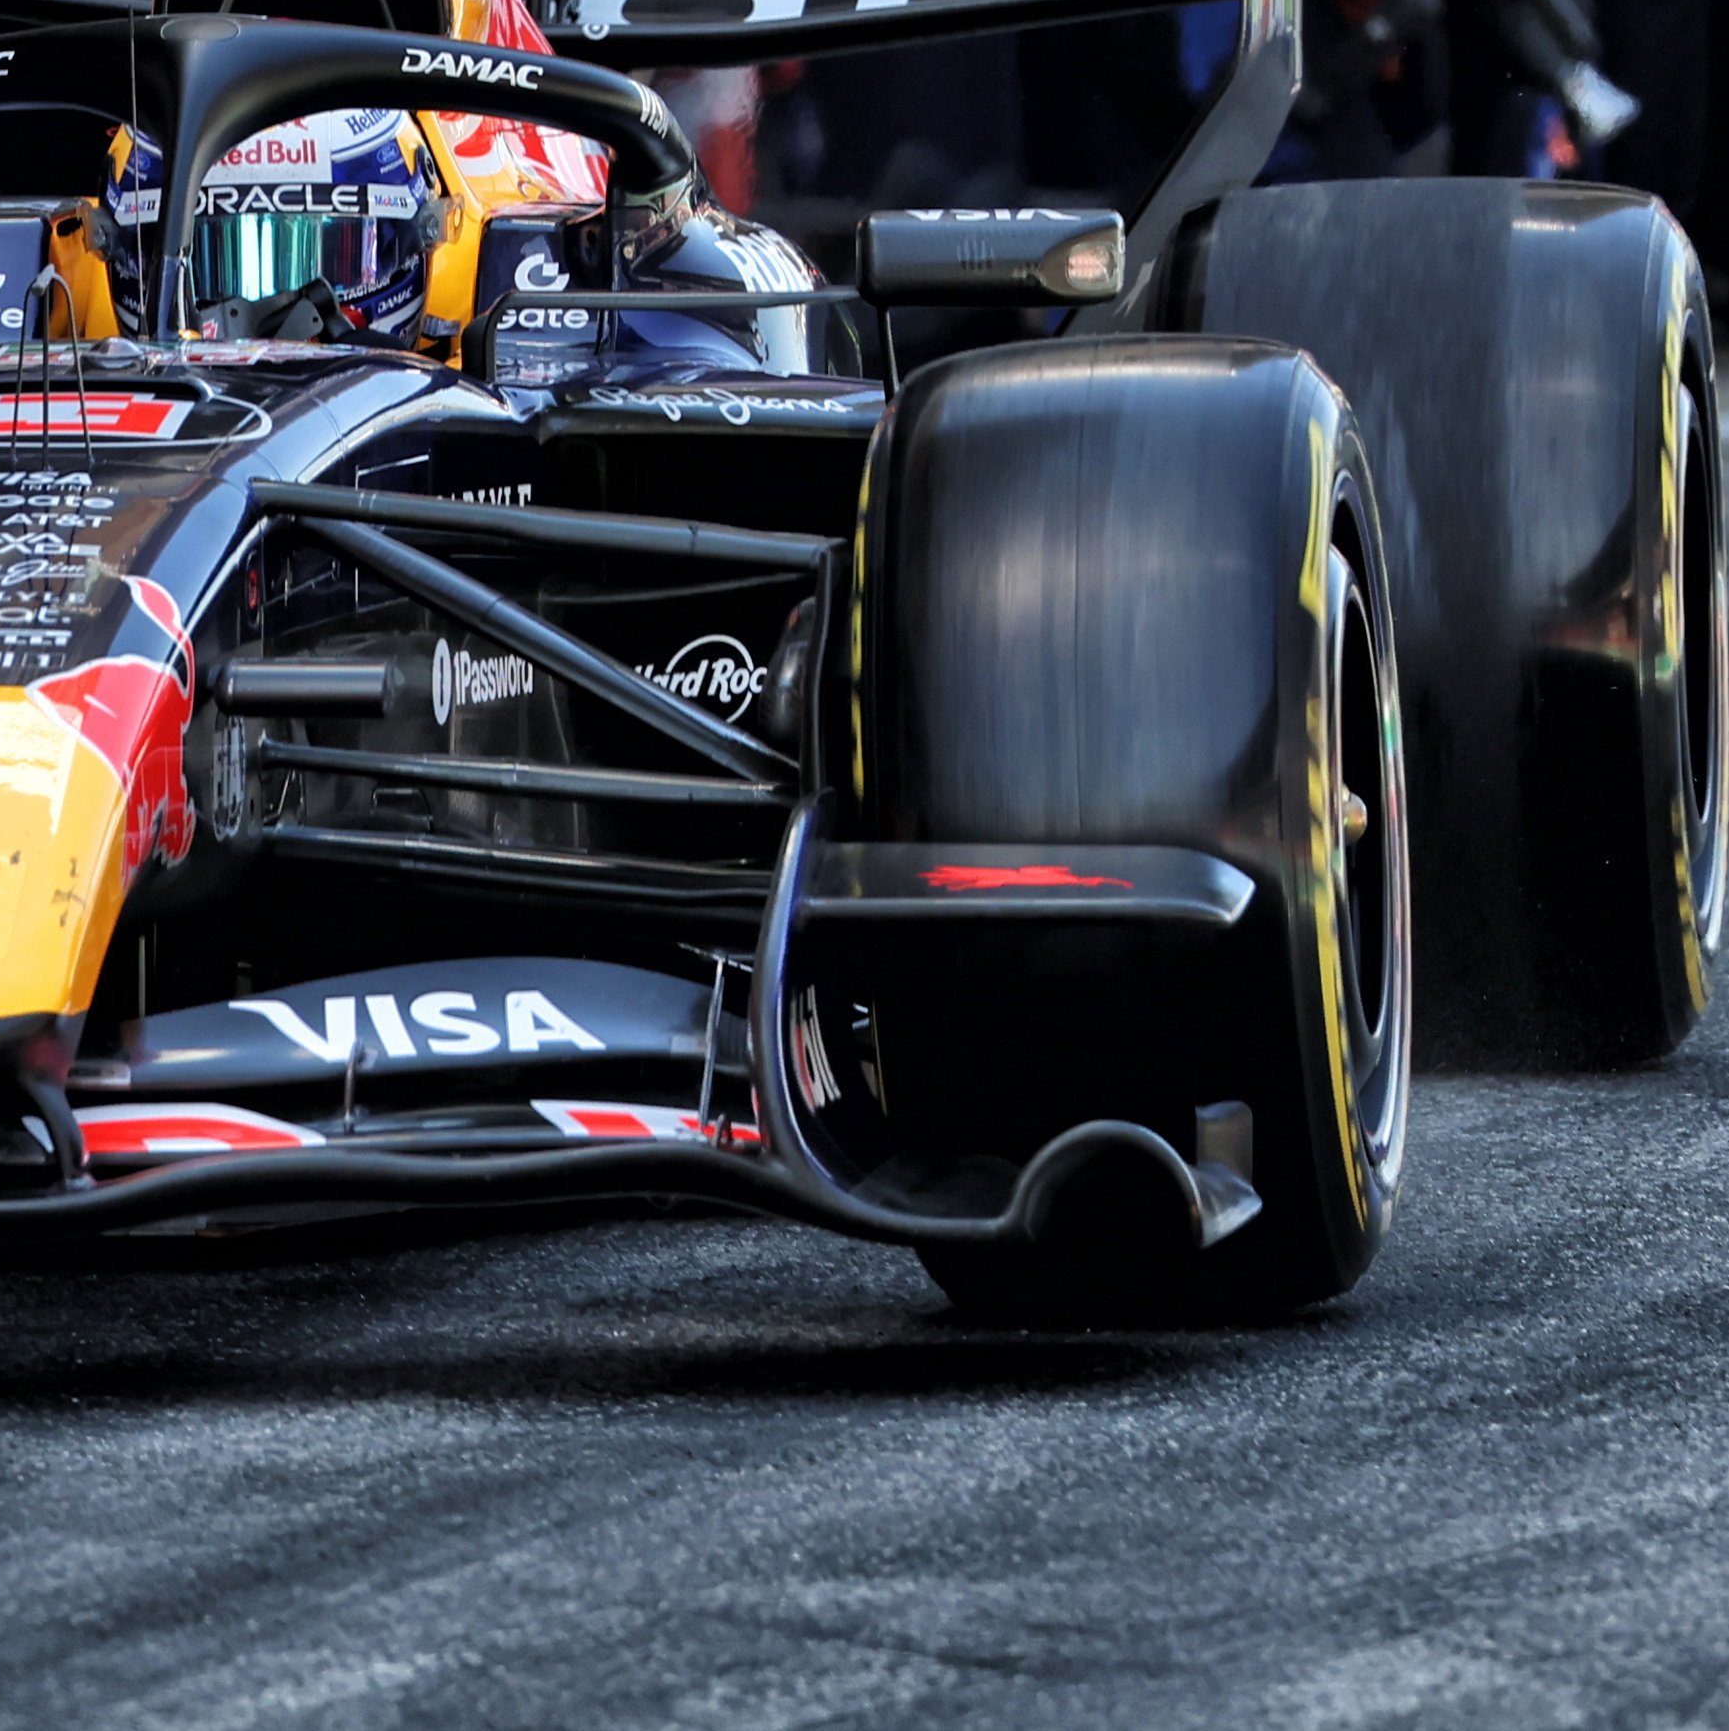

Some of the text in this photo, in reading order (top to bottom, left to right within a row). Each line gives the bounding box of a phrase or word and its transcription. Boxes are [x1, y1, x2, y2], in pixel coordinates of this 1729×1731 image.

[401, 47, 544, 91] DAMAC
[266, 139, 317, 165] Bull
[589, 386, 854, 426] Pepe Jeans
[2, 513, 113, 528] AT&T
[1, 559, 85, 586] Jim
[707, 657, 768, 704] Roc
[229, 990, 606, 1063] VISA
